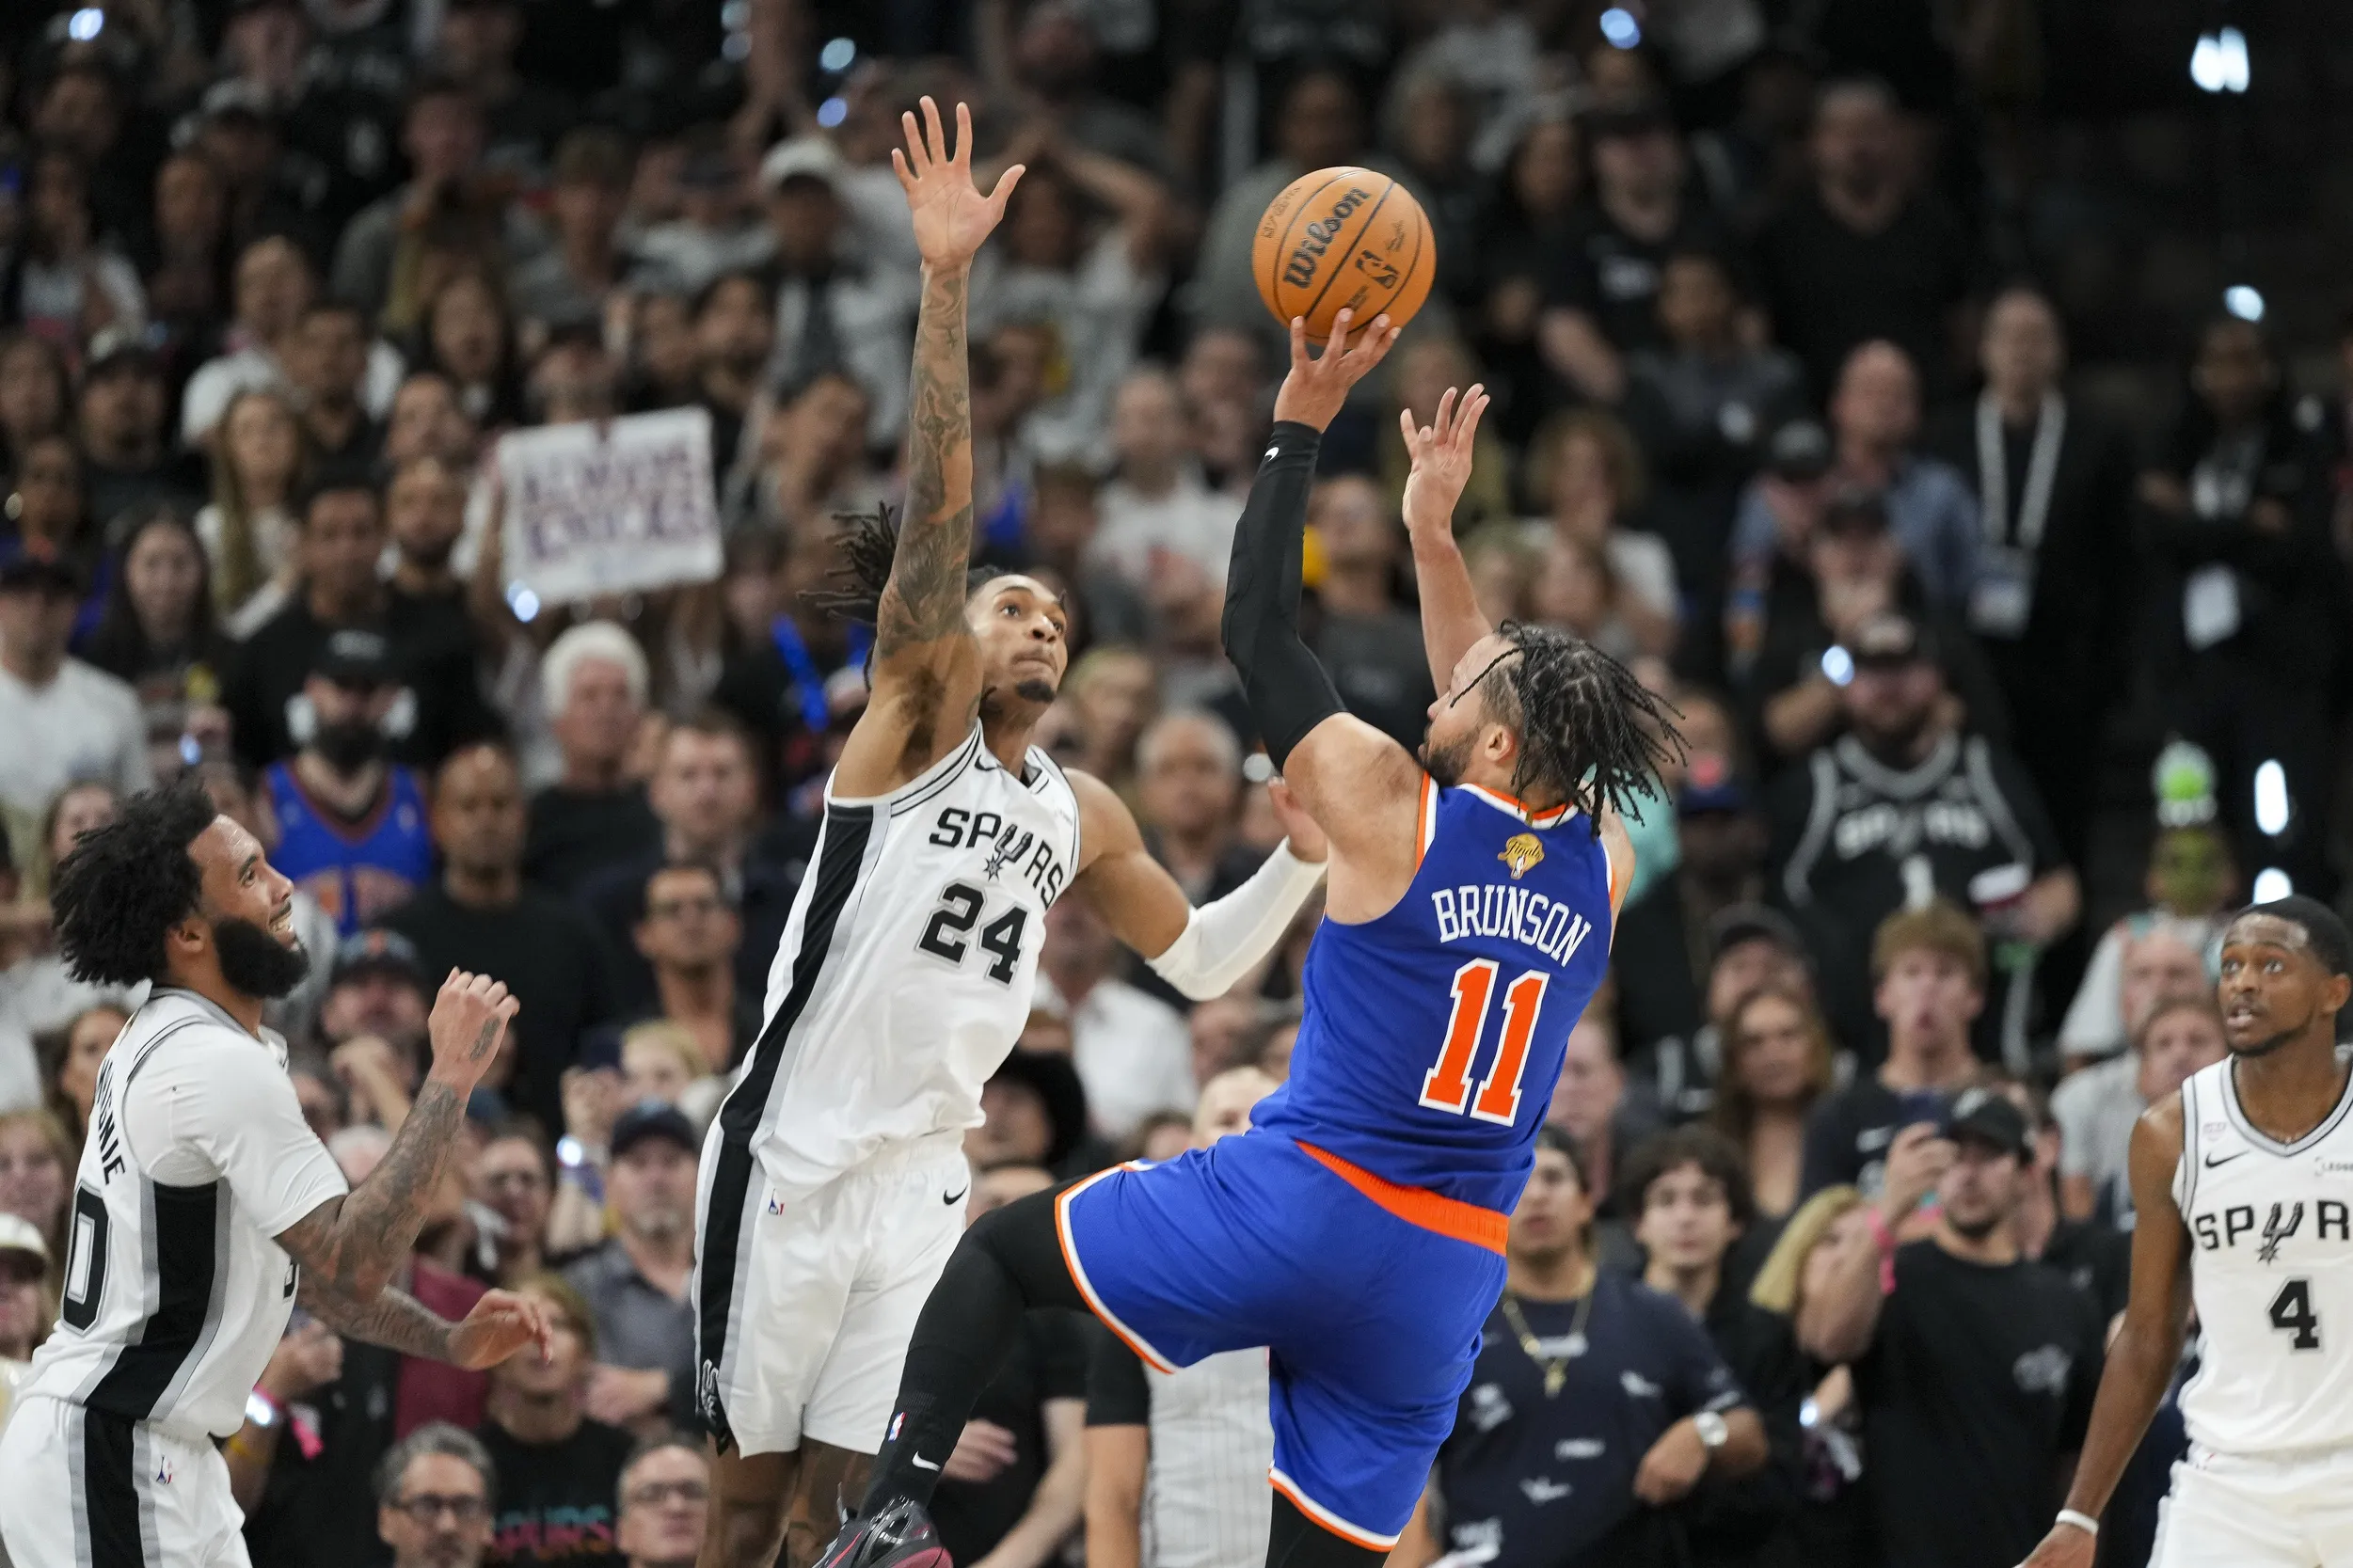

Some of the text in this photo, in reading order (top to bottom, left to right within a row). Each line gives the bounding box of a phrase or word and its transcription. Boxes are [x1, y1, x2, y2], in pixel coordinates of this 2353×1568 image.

[1281, 187, 1372, 289] Wilson
[929, 806, 1065, 911] SPURS
[915, 879, 1031, 988] 24
[1431, 884, 1593, 968] BRUNSON
[1418, 957, 1550, 1128] 11
[2266, 1276, 2324, 1353] 4
